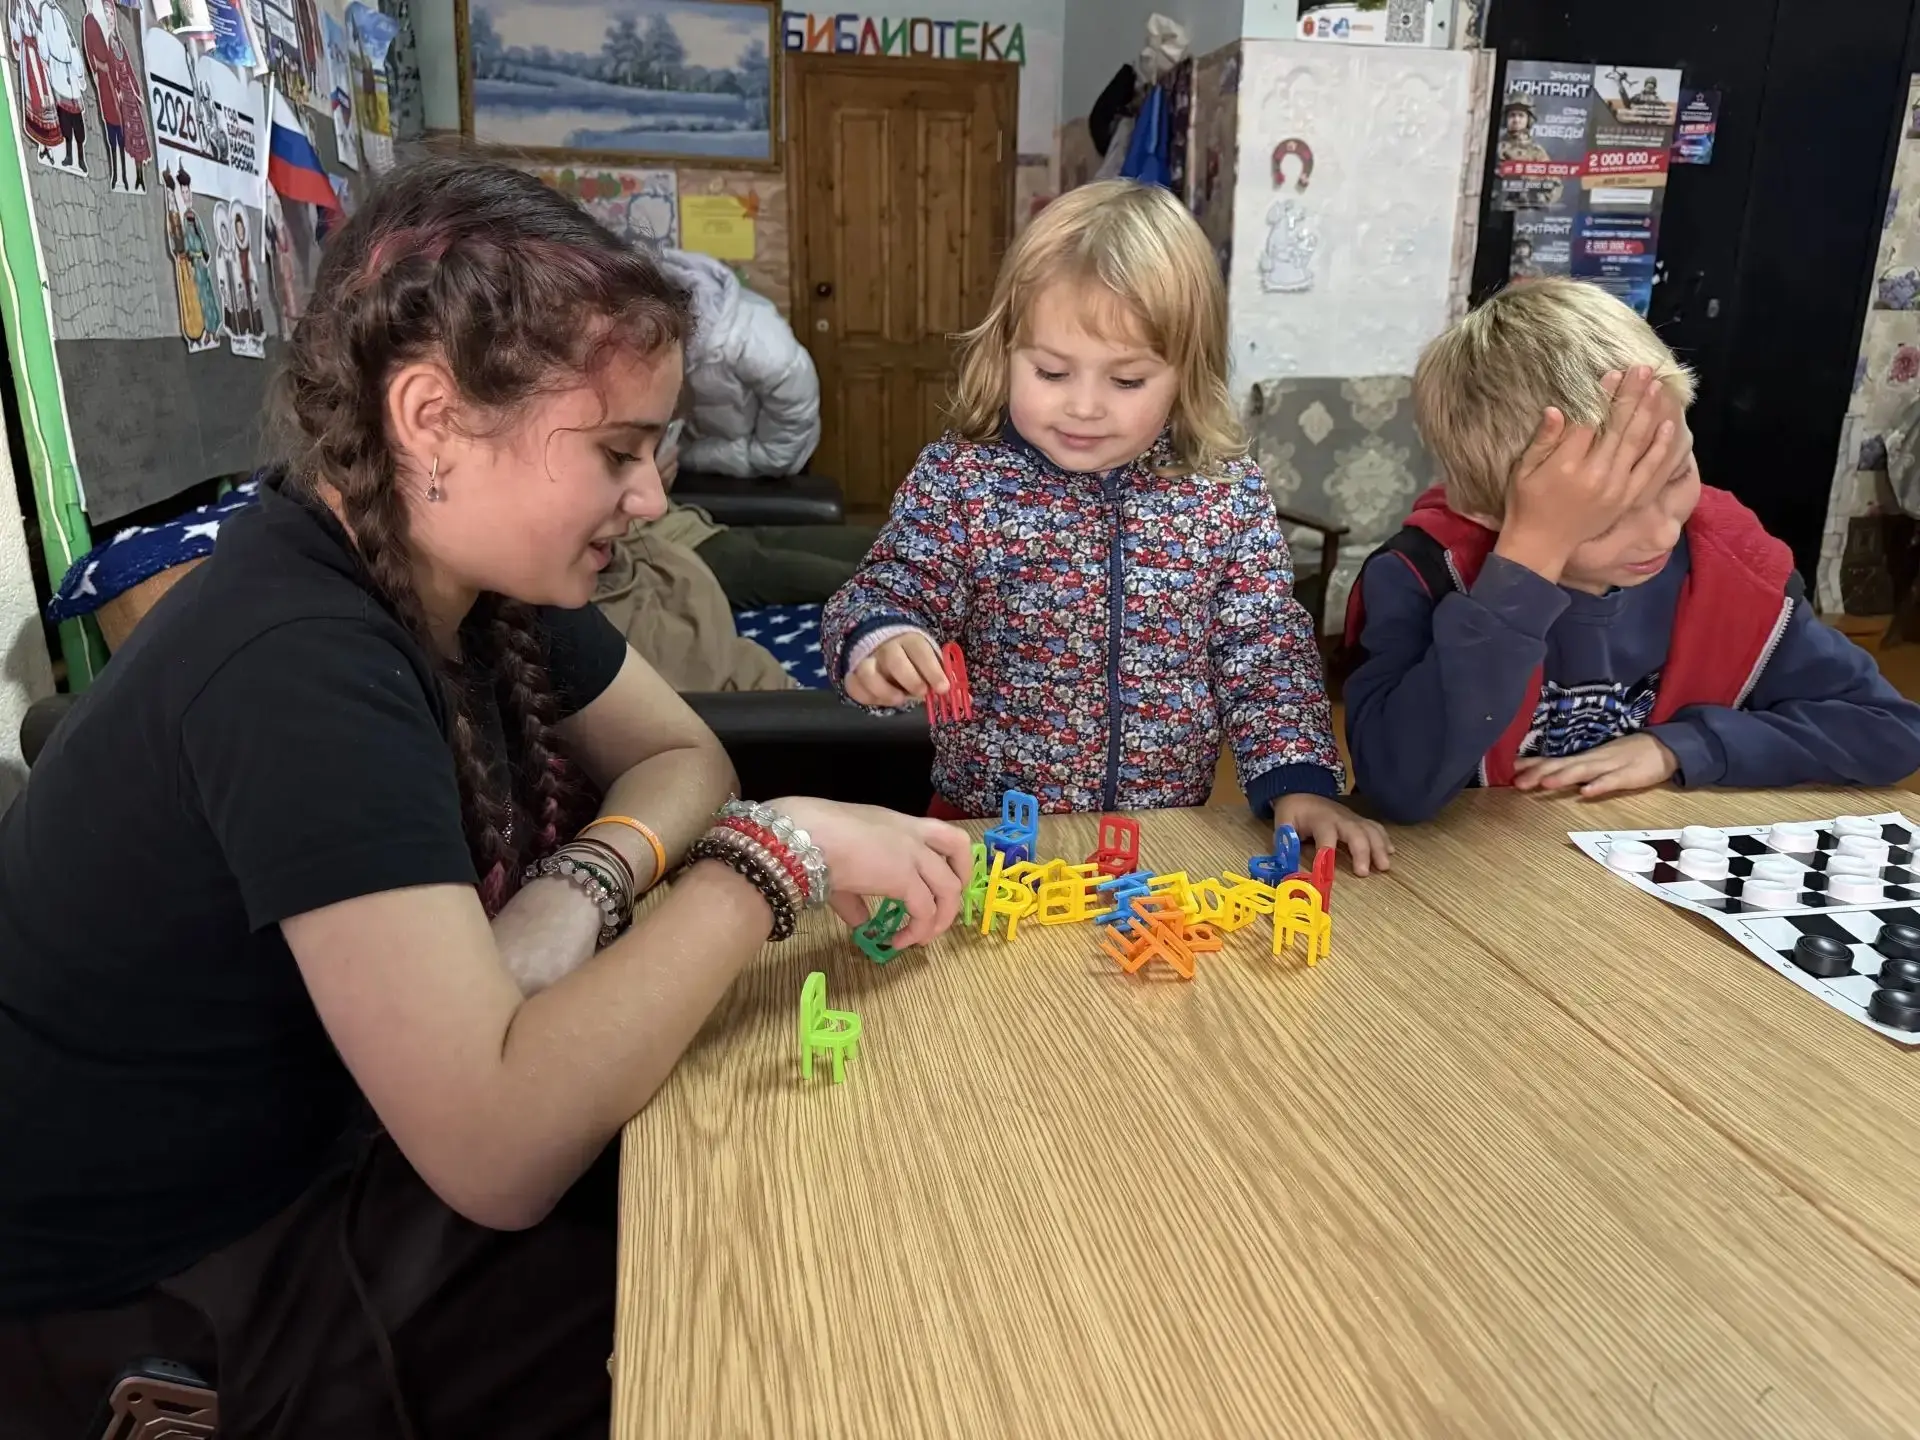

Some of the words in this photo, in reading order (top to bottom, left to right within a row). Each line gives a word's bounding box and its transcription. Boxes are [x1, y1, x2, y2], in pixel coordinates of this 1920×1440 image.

[782, 11, 1026, 66] БИБЛИОТЕКА
[1509, 80, 1590, 98] КОНТРАКТ
[153, 87, 197, 143] 2026
[1530, 124, 1585, 140] ПОБЕДЫ
[1589, 155, 1598, 167] 2
[1601, 153, 1624, 166] 000
[1626, 152, 1649, 165] 000
